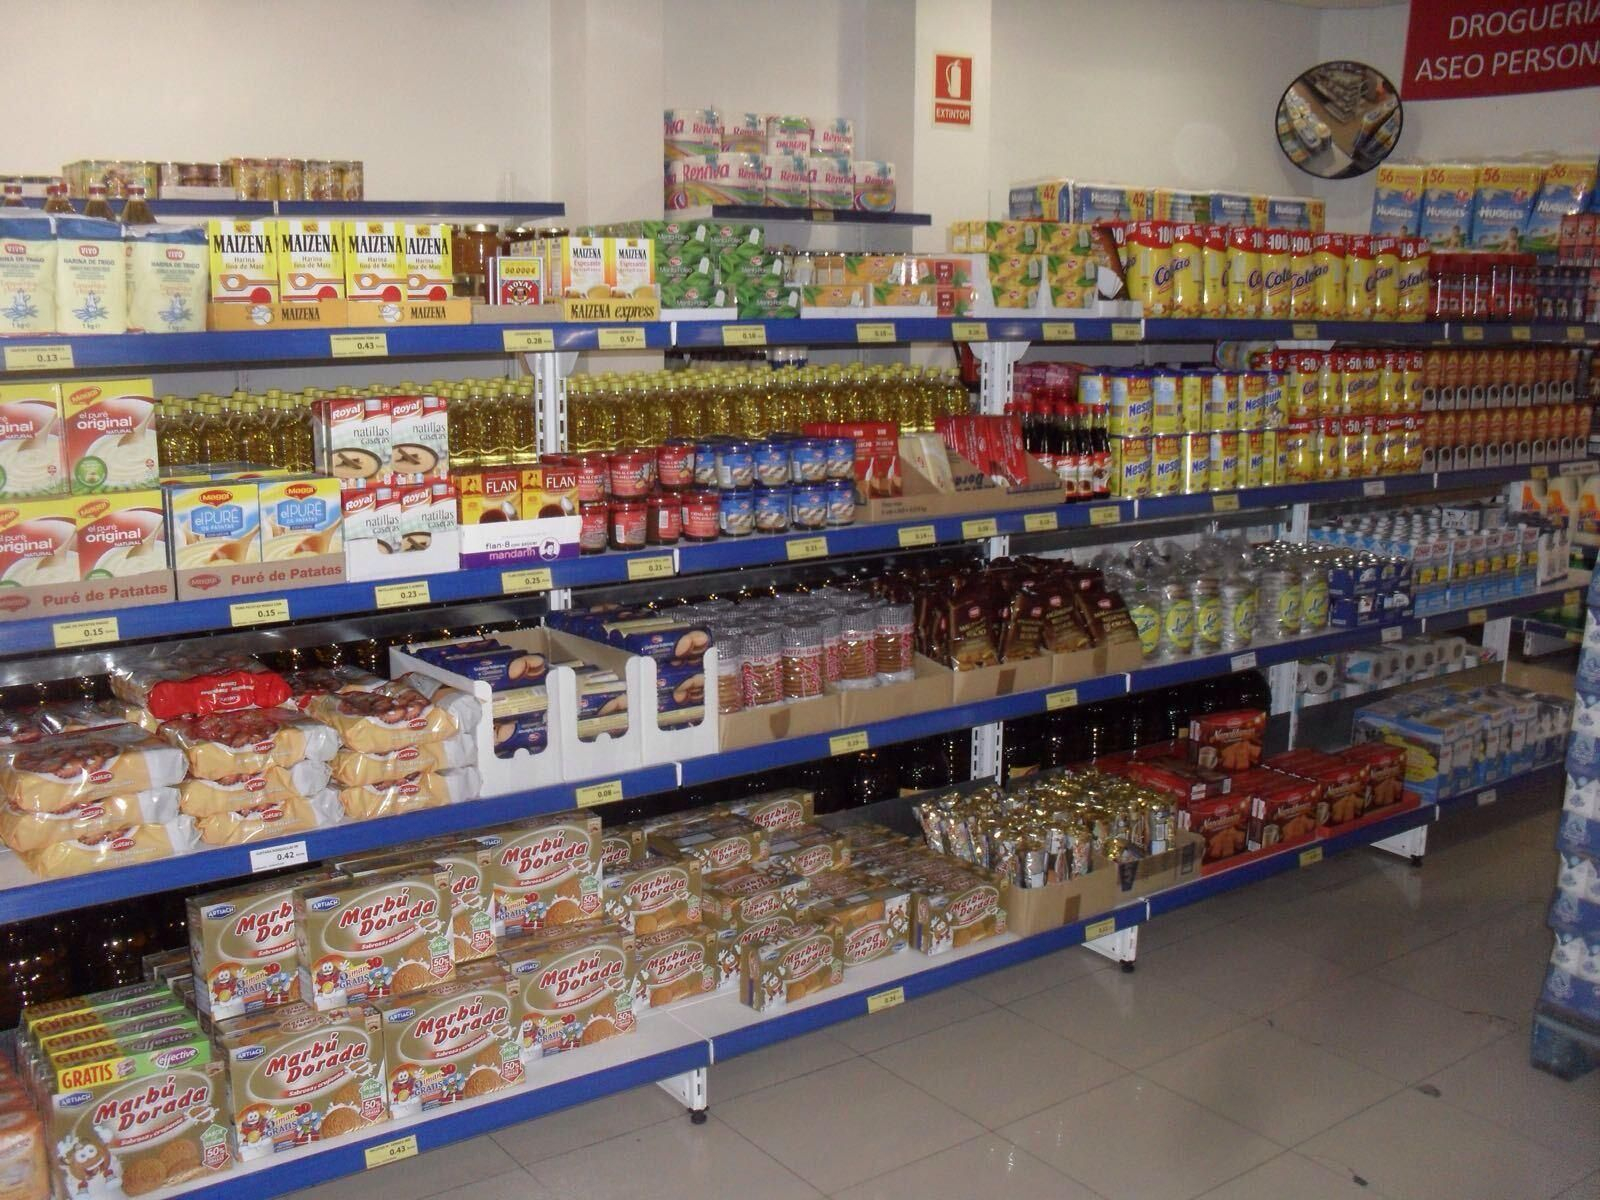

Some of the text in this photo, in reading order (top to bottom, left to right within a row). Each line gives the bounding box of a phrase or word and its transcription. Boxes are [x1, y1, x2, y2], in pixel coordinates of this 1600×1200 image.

[1415, 39, 1600, 81] ASEO PERSON
[936, 107, 970, 120] EXTINTOR
[683, 163, 730, 182] Renova
[1379, 170, 1393, 182] 56
[1430, 170, 1445, 183] 56
[1483, 167, 1500, 182] 56
[1044, 185, 1055, 200] 42
[1134, 192, 1145, 208] 42
[213, 234, 272, 254] MAIZENA
[282, 233, 339, 253] MAIZENA
[349, 234, 402, 254] MAIZENA
[81, 247, 98, 256] VIVO
[572, 247, 601, 259] MAIZENA
[618, 248, 647, 260] MAIZENA
[507, 280, 533, 292] ROYAL
[282, 306, 320, 321] MAIZENA
[410, 306, 446, 320] MAIZENA
[571, 302, 655, 322] MAIZENA express
[357, 342, 375, 350] 0.43
[526, 336, 542, 345] 0.28
[37, 354, 58, 363] 0.13
[332, 403, 361, 420] Royal
[393, 401, 420, 416] Royal
[77, 416, 133, 431] original
[412, 421, 446, 434] natillas
[353, 426, 390, 438] natillas
[420, 433, 446, 441] caseras
[361, 437, 390, 445] caseras
[486, 480, 517, 493] FLAN
[546, 476, 576, 489] FLAN
[202, 492, 230, 501] Maggi
[287, 486, 315, 496] Maggi
[402, 489, 429, 505] Royal
[345, 494, 373, 511] Royal
[365, 514, 400, 527] natillas
[421, 510, 455, 521] natillas
[97, 524, 117, 533] puré
[372, 525, 400, 535] caseras
[428, 520, 455, 530] caseras
[85, 528, 141, 544] original
[231, 565, 342, 585] Puré de Patatas
[42, 584, 168, 608] Puré de Patatas
[400, 590, 417, 599] 0.23
[258, 609, 276, 618] 0.15
[84, 628, 104, 637] 0.15
[277, 852, 295, 861] 0.42
[502, 831, 565, 866] Marbú
[518, 841, 589, 875] Dorada
[629, 871, 671, 896] Marbú
[641, 878, 685, 901] Dorada
[312, 898, 340, 911] ARTIACH
[339, 887, 409, 928] Marbú
[950, 890, 985, 912] Marbú
[960, 894, 997, 915] Dorada
[207, 905, 235, 919] ARTIACH
[359, 899, 436, 937] Dorada
[500, 907, 526, 921] GRATIS
[741, 919, 778, 943] Marbú
[647, 946, 687, 970] Marbú
[784, 941, 818, 965] Marbú
[793, 946, 831, 970] Dorada
[515, 961, 541, 974] ARTIACH
[539, 952, 600, 989] Marbú
[657, 951, 702, 976] Dorada
[339, 973, 369, 989] GRATIS
[557, 961, 622, 996] Dorada
[236, 980, 267, 997] GRATIS
[111, 998, 169, 1018] effective
[388, 1008, 415, 1021] ARTIACH
[36, 1010, 98, 1033] GRATIS
[119, 1013, 183, 1032] effective
[415, 996, 482, 1038] Marbú
[434, 1006, 507, 1044] Dorada
[47, 1026, 111, 1048] GRATIS
[132, 1031, 194, 1050] effective
[537, 1029, 562, 1043] GRATIS
[53, 1043, 119, 1064] GRATIS
[156, 1048, 198, 1067] effective
[236, 1047, 265, 1060] ARTIACH
[265, 1032, 339, 1077] Marbú
[286, 1042, 366, 1084] Dorada
[62, 1062, 113, 1089] GRATIS
[414, 1081, 443, 1096] GRATIS
[59, 1093, 92, 1107] ARTIACH
[93, 1074, 176, 1124] Marbú
[117, 1086, 209, 1132] Dorada
[266, 1121, 297, 1137] GRATIS
[389, 1144, 406, 1157] 0.43
